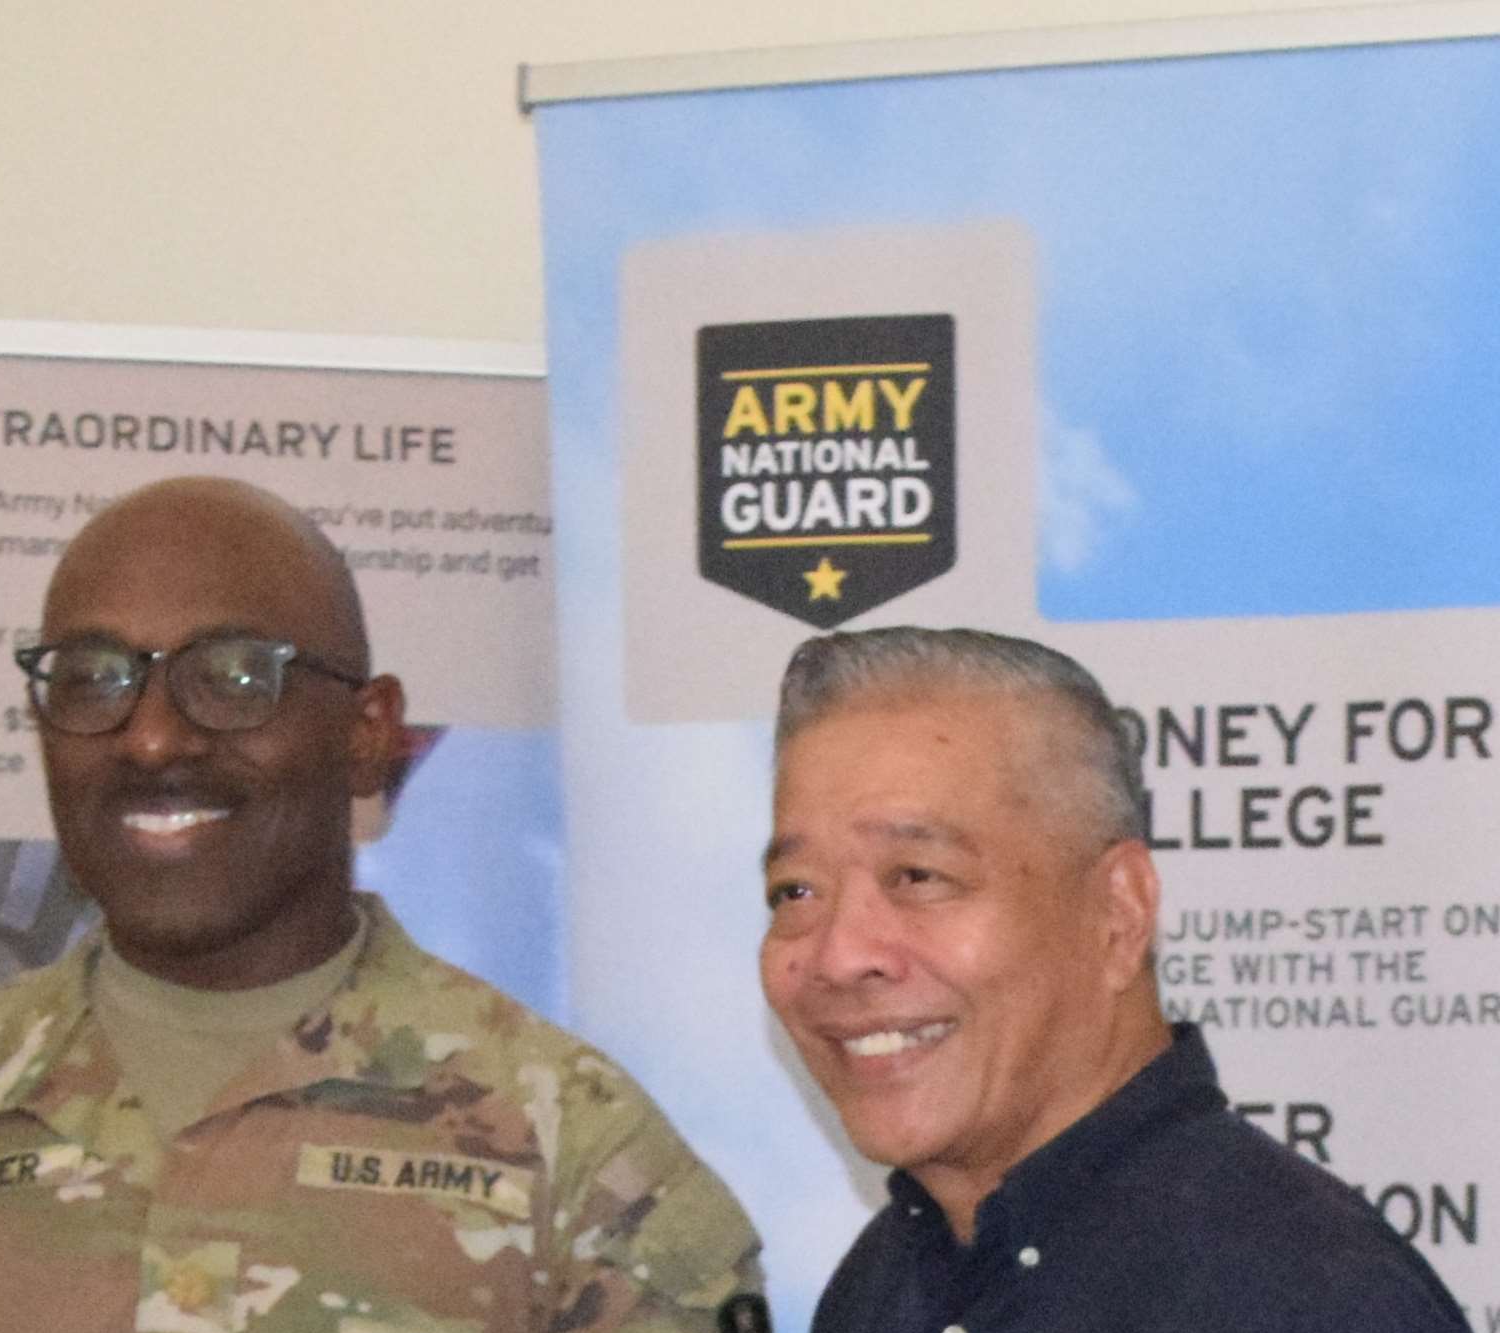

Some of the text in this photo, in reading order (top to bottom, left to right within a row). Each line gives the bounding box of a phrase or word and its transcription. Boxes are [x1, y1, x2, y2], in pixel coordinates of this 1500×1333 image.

[722, 378, 927, 438] ARMY
[353, 424, 457, 464] LIFE
[721, 438, 930, 477] NATIONAL
[390, 508, 435, 532] put
[720, 477, 933, 534] GUARD
[440, 552, 491, 574] and
[497, 555, 541, 580] get
[1344, 697, 1494, 763] FOR
[1166, 904, 1500, 943] JUMP-START ON
[1231, 953, 1334, 985] WITH
[1350, 951, 1427, 983] THE
[1165, 997, 1376, 1029] NATIONAL
[394, 1160, 502, 1198] ARMY
